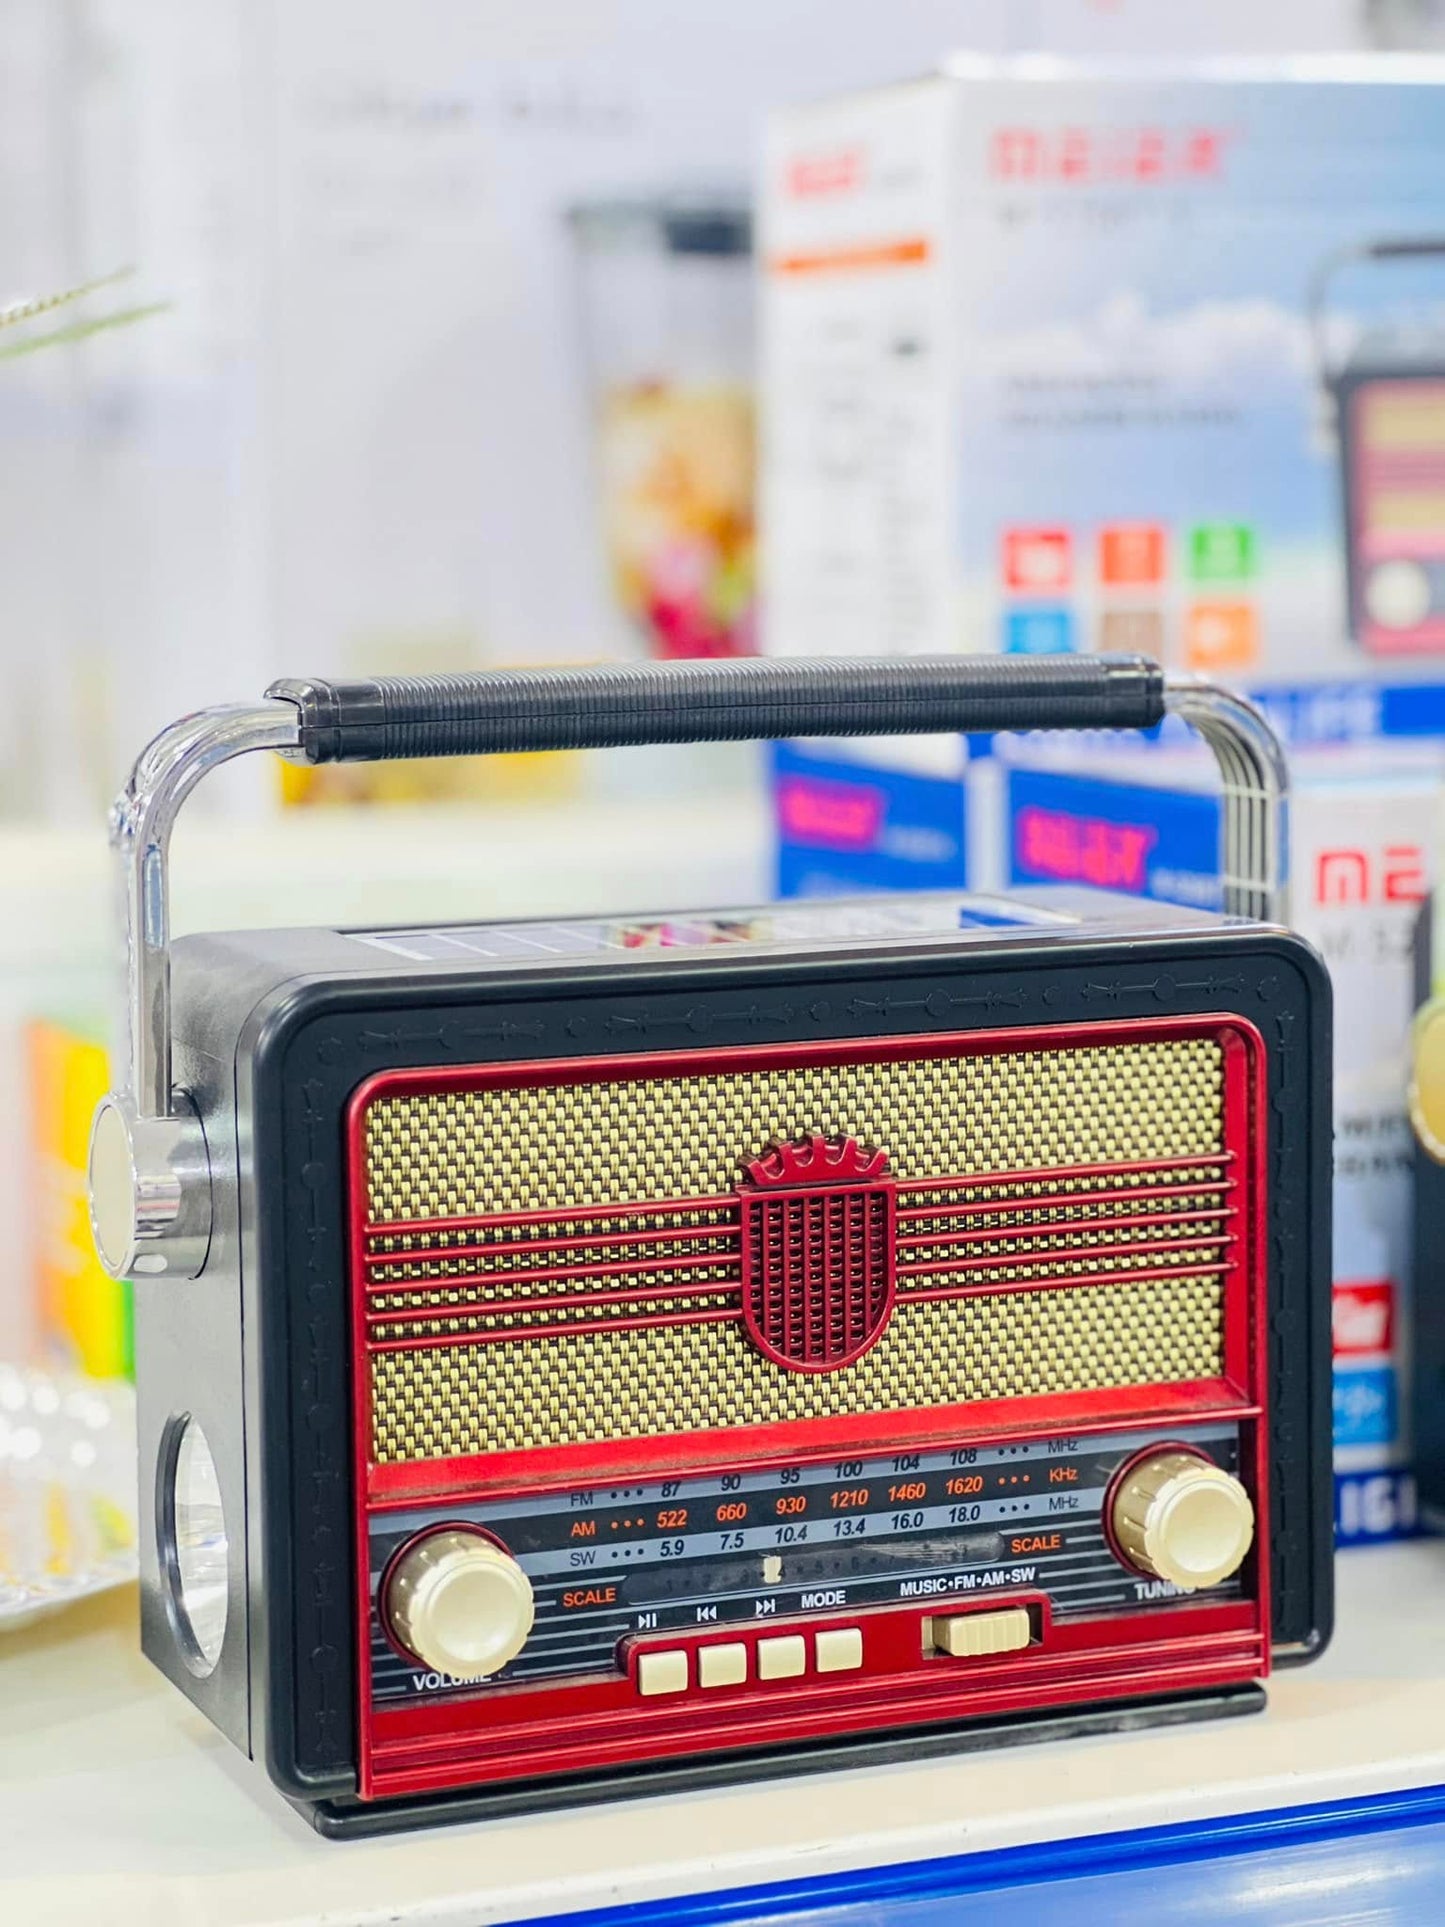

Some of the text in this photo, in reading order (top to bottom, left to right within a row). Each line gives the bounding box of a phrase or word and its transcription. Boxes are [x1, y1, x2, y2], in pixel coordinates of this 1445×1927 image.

[570, 1438, 1078, 1507] FM 87 90 95 100 104 108 MHz
[570, 1466, 1079, 1537] AM 522 660 930 1210 1460 1620 KHz
[569, 1496, 1079, 1567] SW 5.9 7.5 10.4 13.4 16.0 18.0 MHz
[1010, 1534, 1062, 1554] SCALE
[562, 1587, 617, 1608] SCALE
[801, 1589, 847, 1609] MODE
